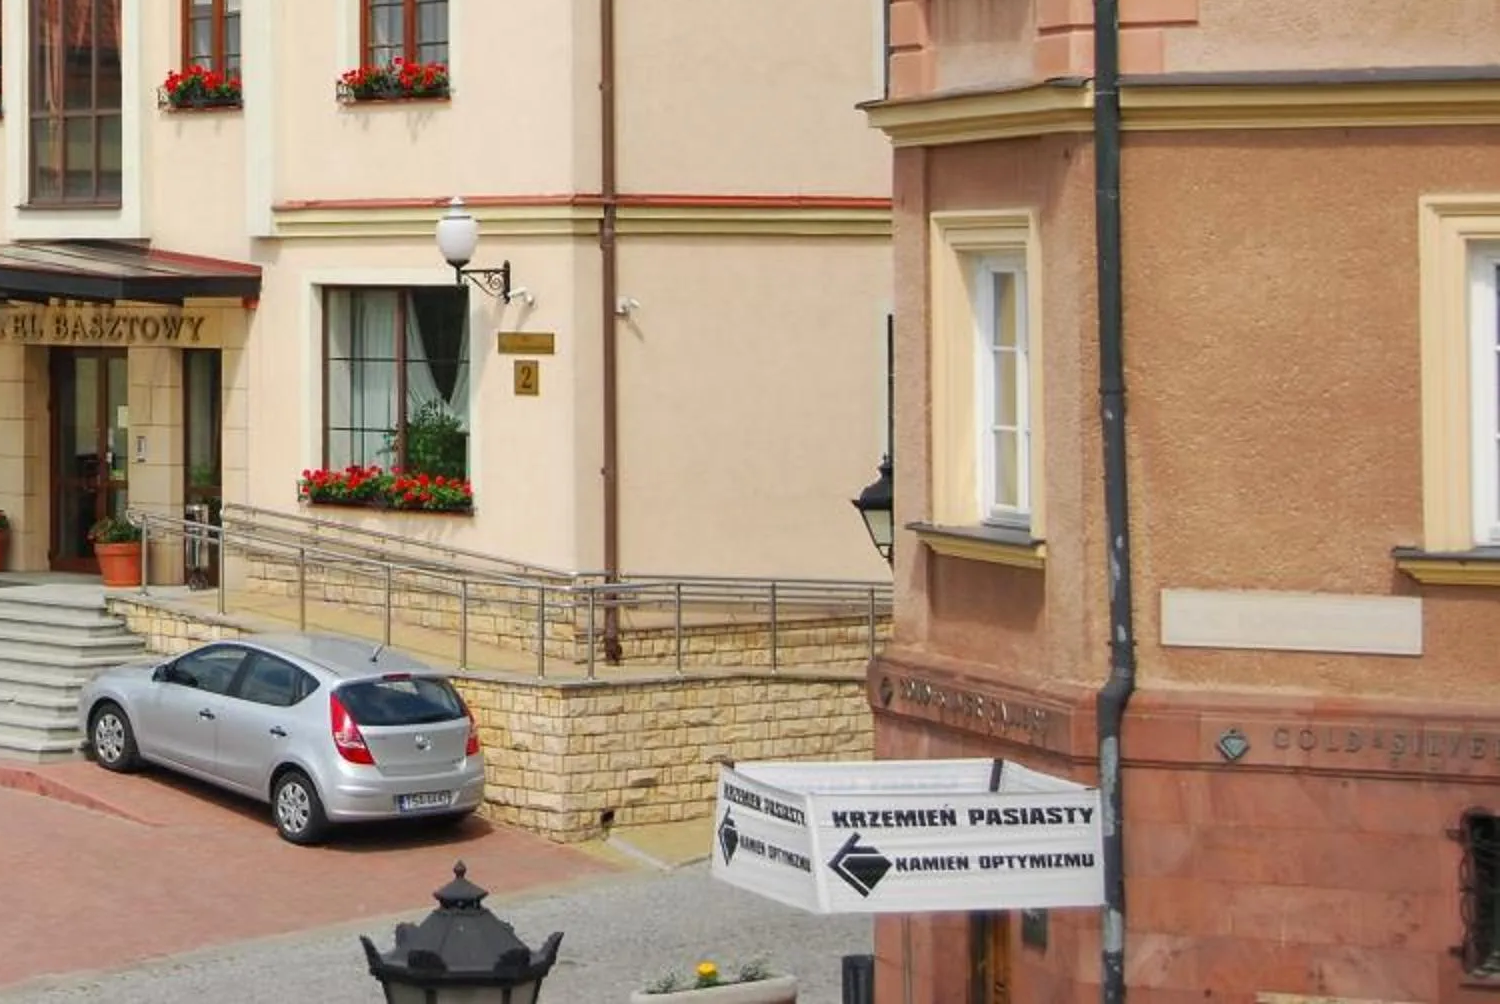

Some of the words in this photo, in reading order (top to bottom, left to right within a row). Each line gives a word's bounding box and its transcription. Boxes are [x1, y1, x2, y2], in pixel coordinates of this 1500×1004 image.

[52, 315, 205, 341] BASZTOWY
[520, 365, 533, 389] 2
[831, 803, 958, 829] KRZEMIEŃ
[968, 806, 1094, 827] PASIASTY
[979, 852, 1095, 869] OPTYMIZMU
